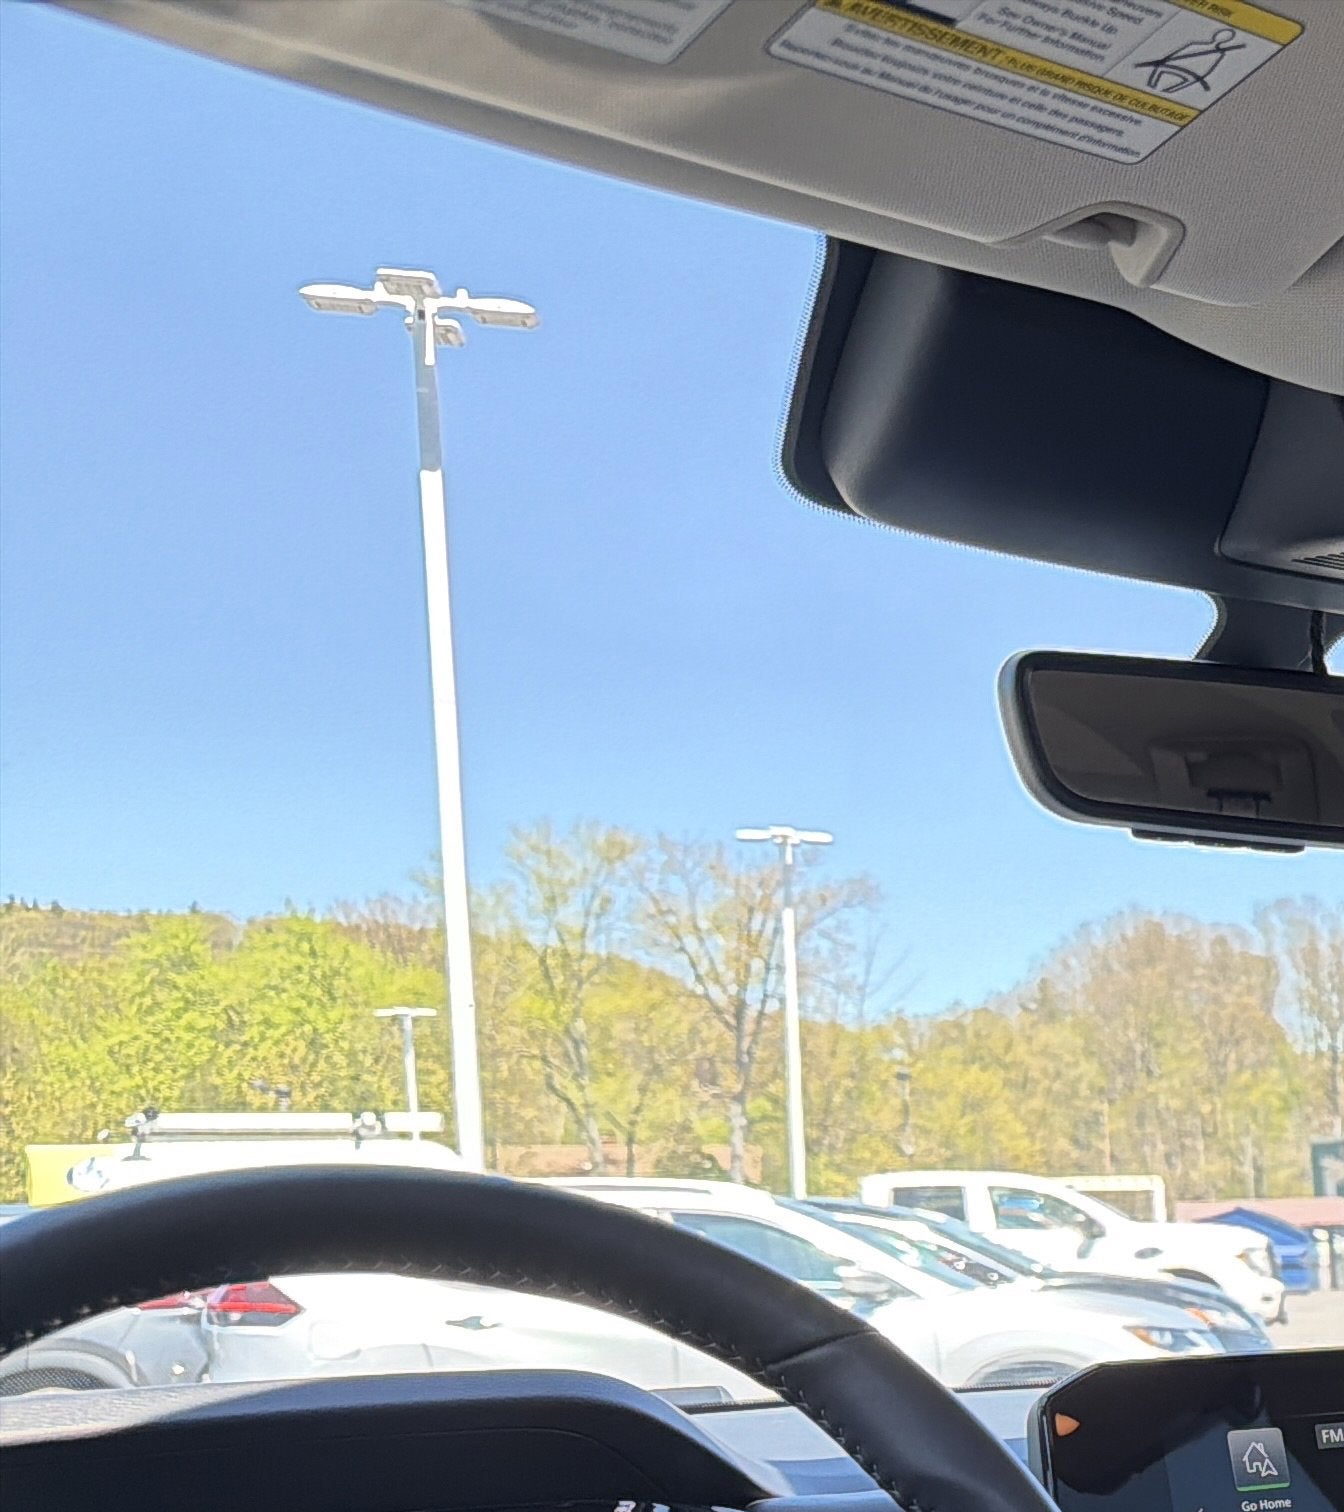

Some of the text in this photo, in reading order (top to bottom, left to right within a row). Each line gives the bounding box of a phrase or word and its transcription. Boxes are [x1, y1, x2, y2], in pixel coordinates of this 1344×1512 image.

[1321, 1427, 1344, 1443] FM
[1241, 1498, 1292, 1512] Go Home
